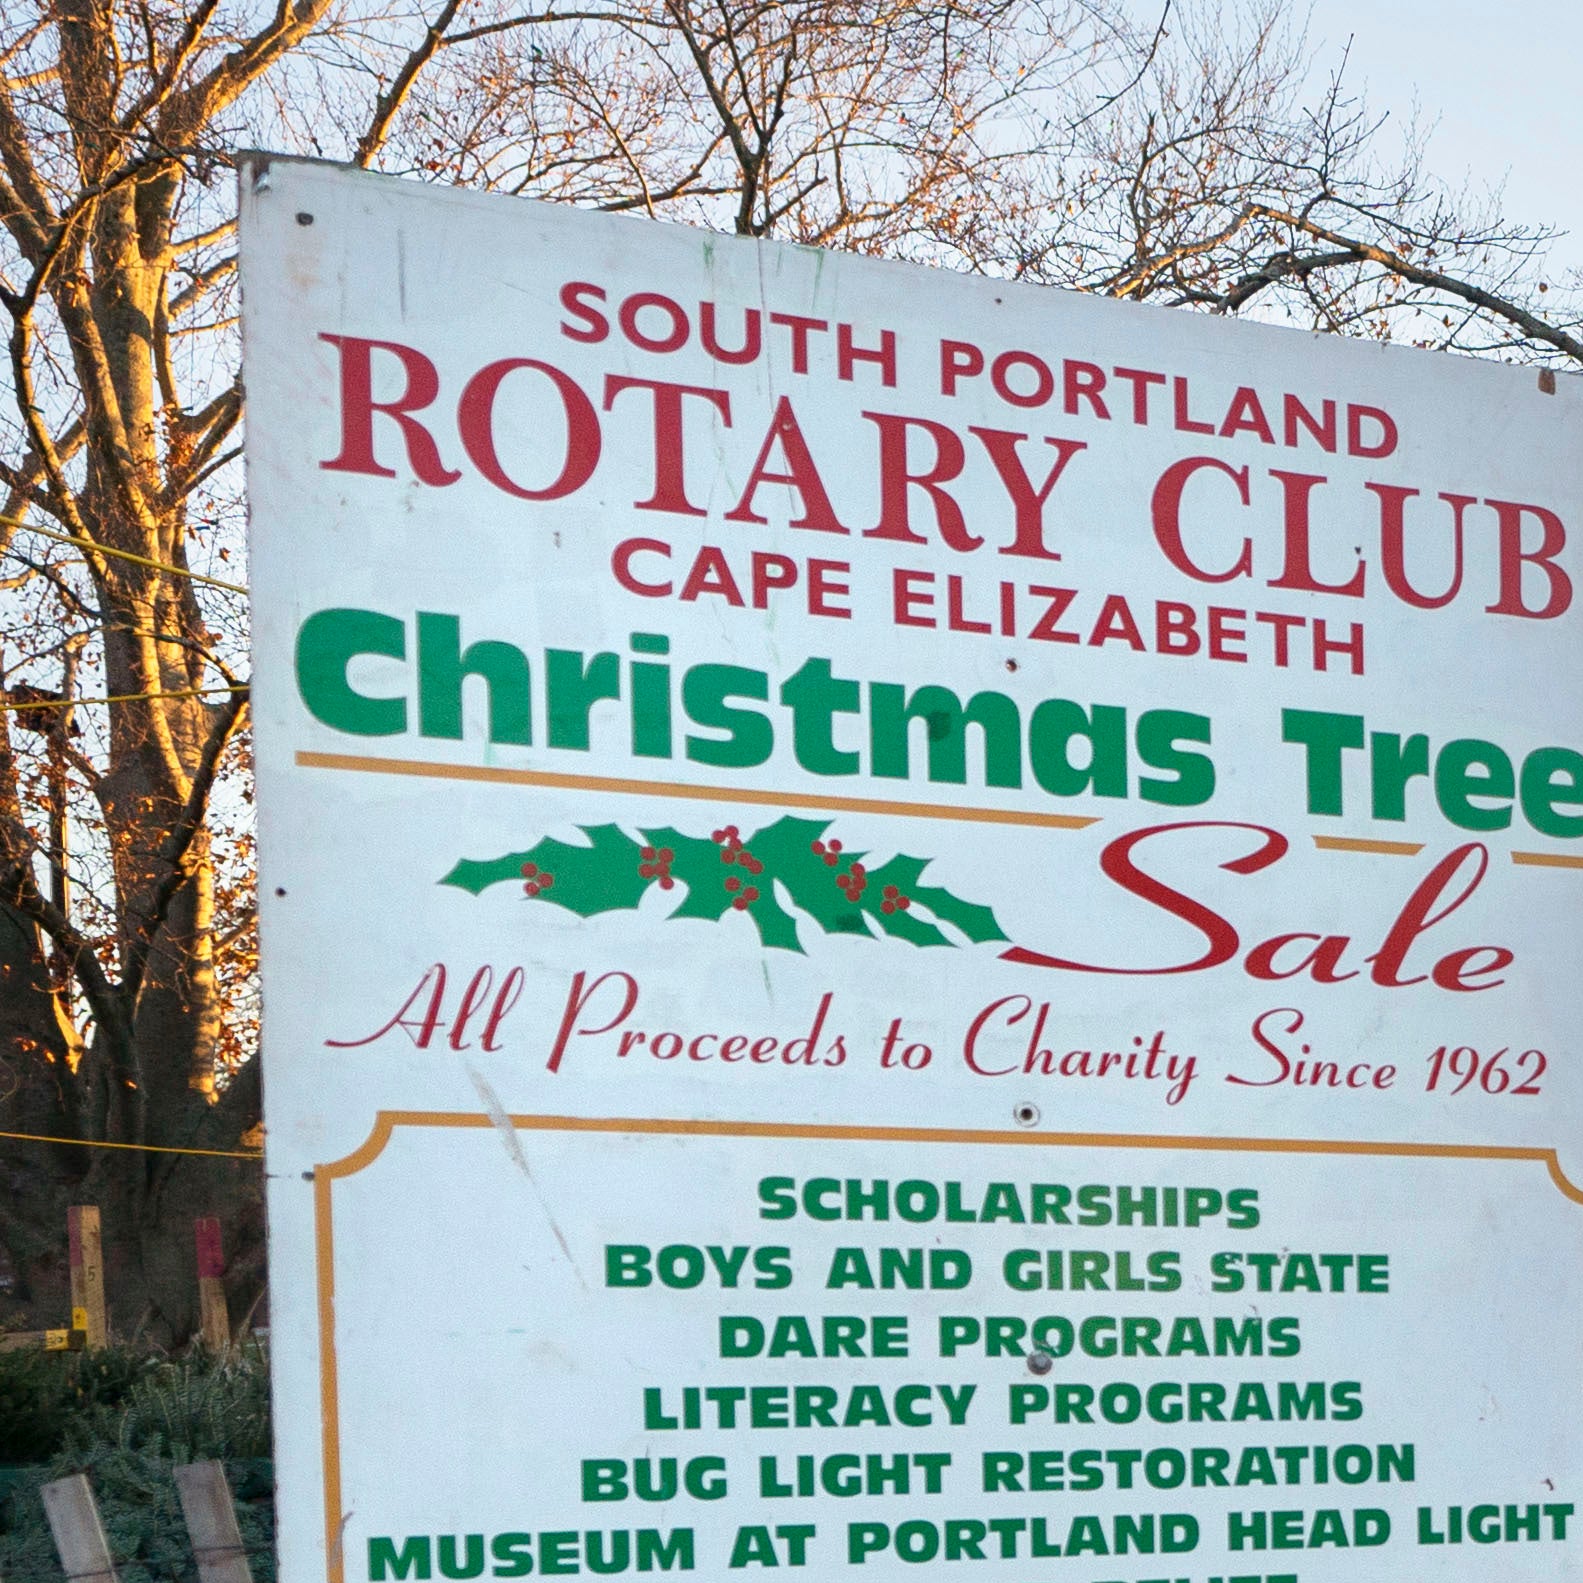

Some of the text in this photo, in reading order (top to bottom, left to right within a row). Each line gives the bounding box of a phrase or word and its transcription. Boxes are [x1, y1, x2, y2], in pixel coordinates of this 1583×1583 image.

[561, 282, 1398, 458] SOUTH PORTLAND
[322, 337, 1572, 618] ROTARY CLUB
[612, 537, 1364, 675] CAPE ELIZABETH
[296, 607, 1216, 807] Christmas
[996, 821, 1514, 992] Sale
[323, 963, 1549, 1103] All Proceeds to Charity Since 1962
[757, 1175, 1260, 1230] SCHOLARSHIPS
[605, 1242, 1391, 1294] BOYS AND GIRLS STATE
[719, 1313, 1302, 1359] DARE PROGRAMS
[642, 1377, 1365, 1431] LITERACY PROGRAMS
[581, 1441, 1417, 1504] BUG LIGHT RESTORATION
[367, 1502, 1576, 1583] MUSEUM AT PORTLAND HEAD LIGHT
